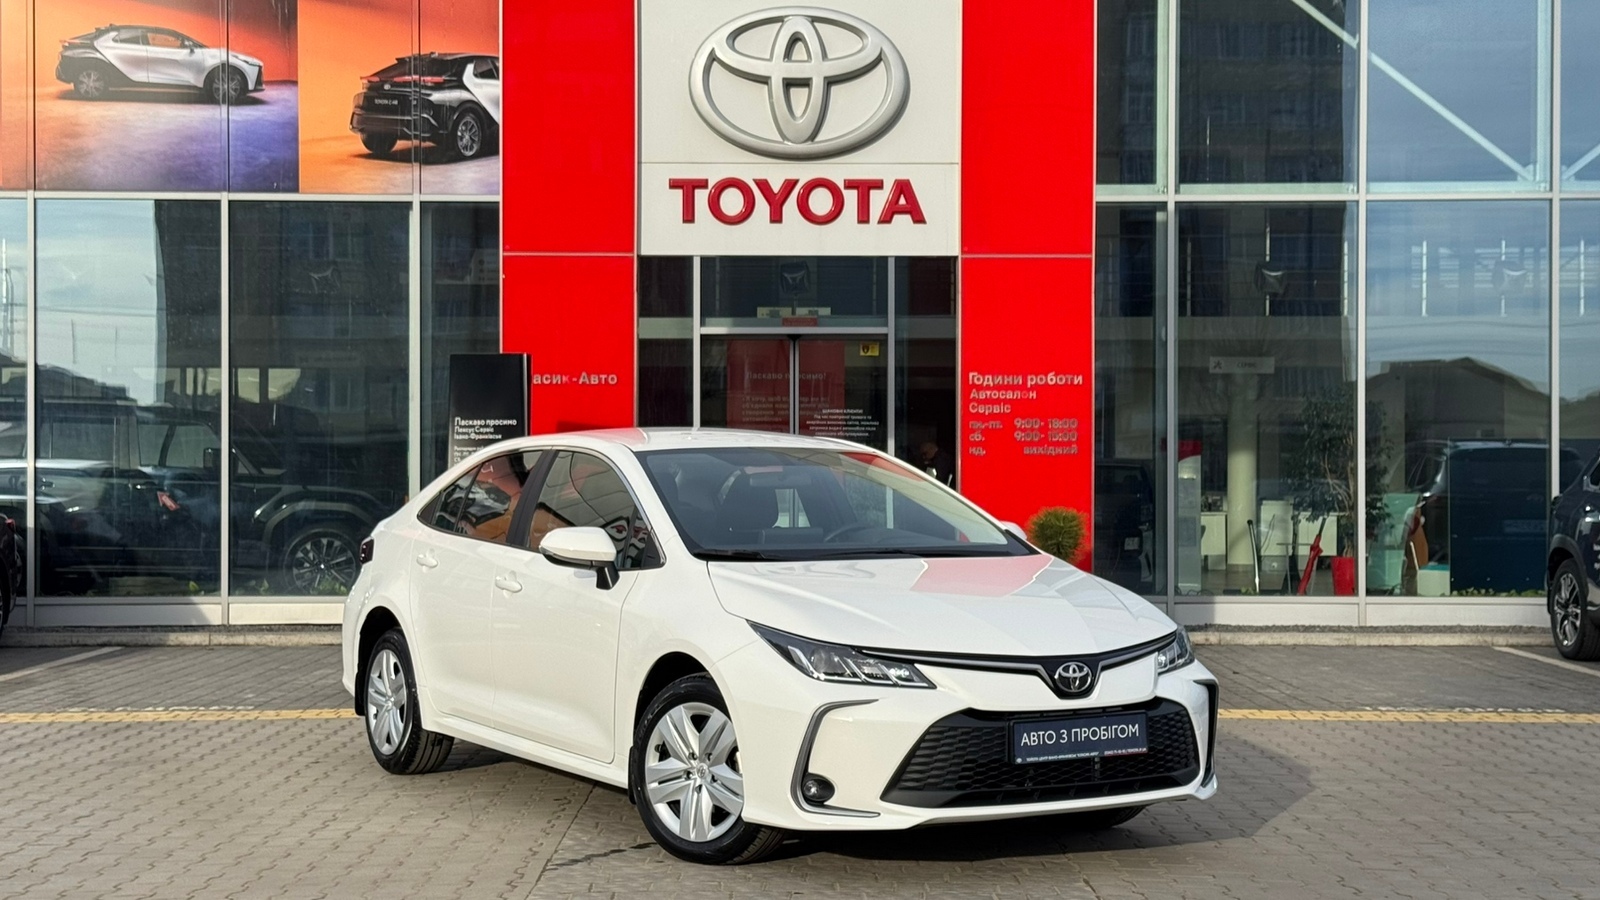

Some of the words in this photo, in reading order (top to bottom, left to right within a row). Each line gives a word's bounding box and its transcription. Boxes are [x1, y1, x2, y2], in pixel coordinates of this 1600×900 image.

[669, 177, 927, 226] TOYOTA
[532, 371, 618, 385] асик-Авто
[968, 372, 1022, 387] Години
[1027, 371, 1083, 388] роботи
[970, 389, 1037, 400] Автосалон
[969, 402, 1012, 415] Сервіс
[1048, 418, 1078, 429] 18:00
[1024, 444, 1078, 456] вихідний
[1020, 730, 1056, 746] АВТО
[1060, 729, 1068, 744] З
[1071, 723, 1139, 742] ПРОБІГОМ
